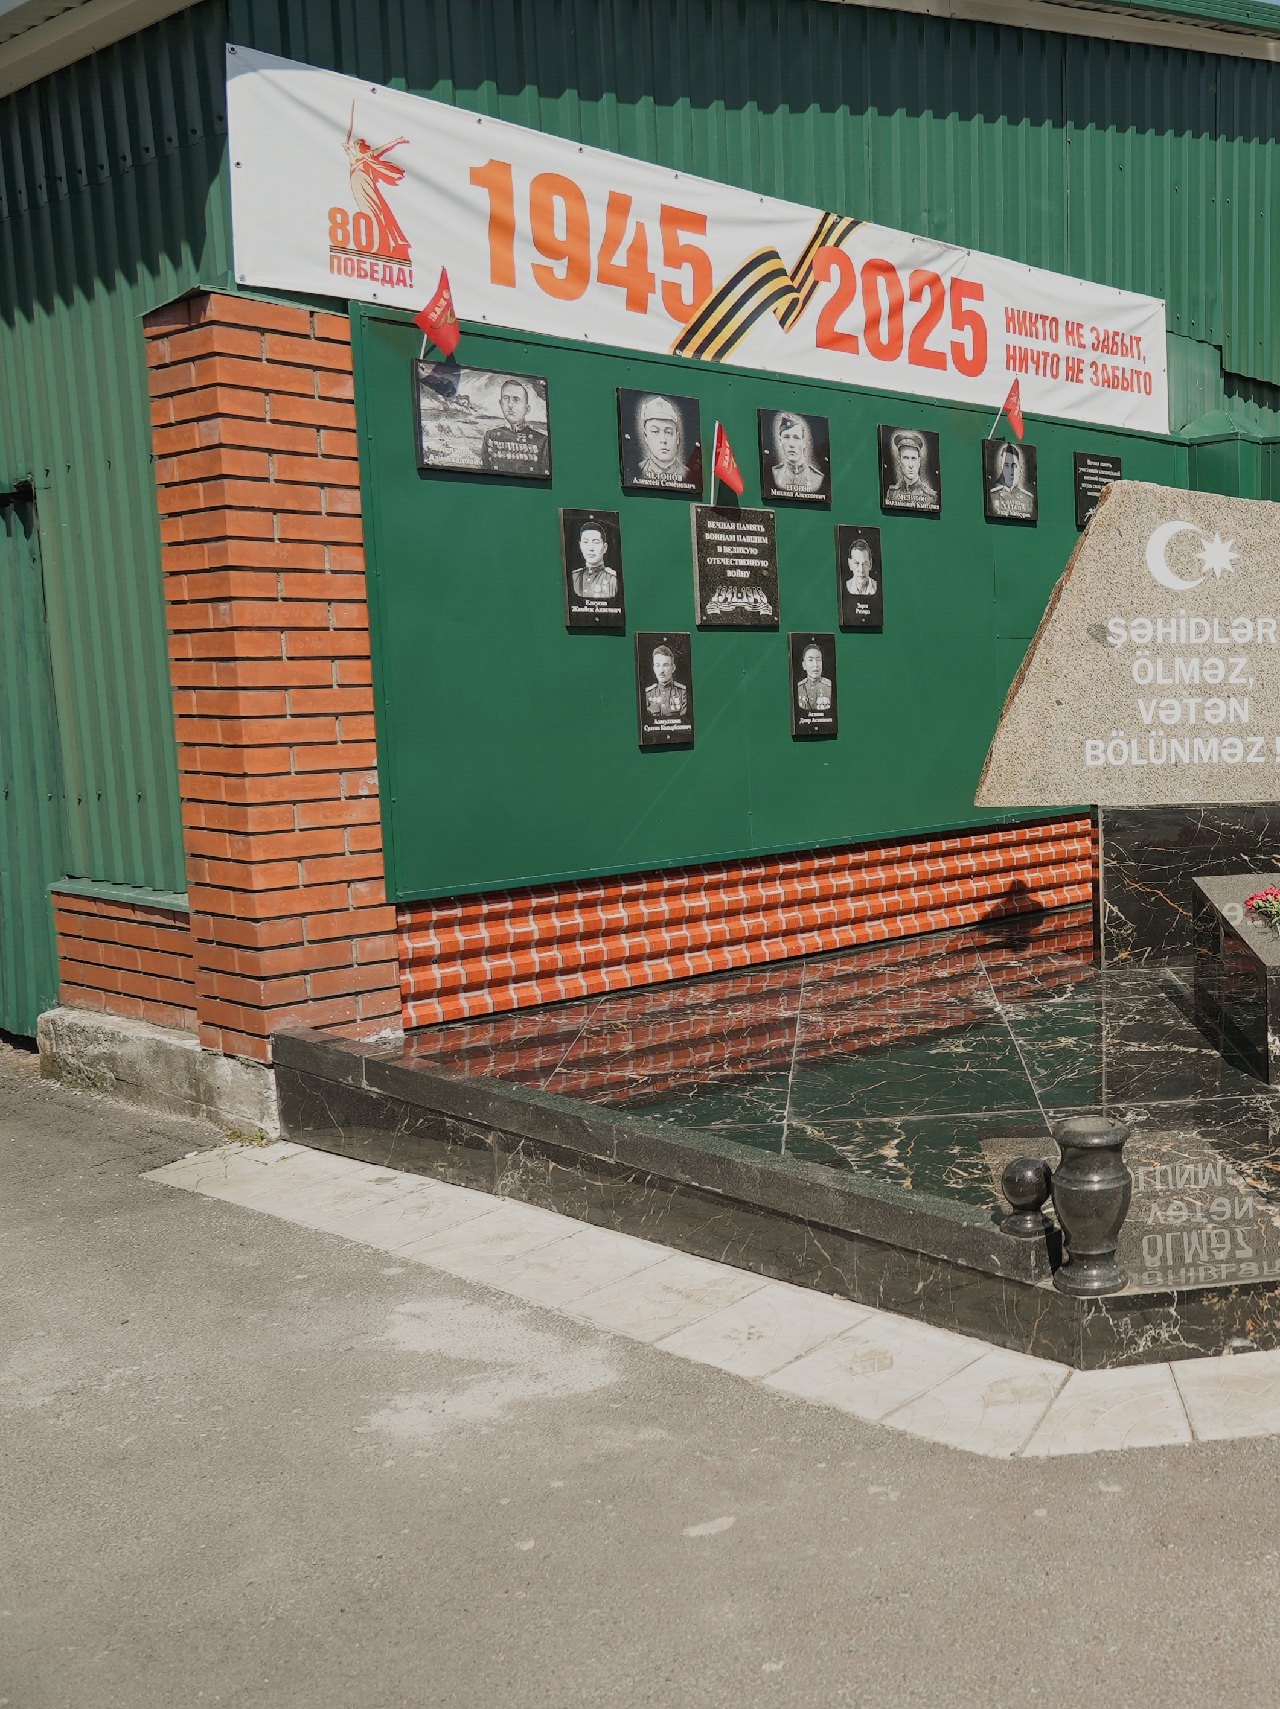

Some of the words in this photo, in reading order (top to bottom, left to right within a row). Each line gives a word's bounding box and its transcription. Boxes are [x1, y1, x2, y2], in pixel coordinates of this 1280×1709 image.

[328, 207, 374, 253] 80
[330, 254, 414, 288] ПОБЕДА!
[469, 159, 713, 324] 1945
[813, 246, 988, 378] 2025
[1004, 306, 1059, 343] НИКТО
[1065, 319, 1087, 349] НЕ
[1090, 326, 1146, 365] ЗАБЫТ,
[1005, 344, 1061, 380] НИЧТО
[1065, 356, 1085, 384] НЕ
[1089, 360, 1153, 396] ЗАБЫТО
[705, 532, 736, 542] ВОИНАМ
[707, 520, 736, 530] ВЕЧНАЯ
[736, 523, 766, 532] ПАМЯТЬ
[706, 557, 769, 568] ОТЕЧЕСТВЕННУЮ
[717, 545, 722, 553] В
[723, 546, 759, 555] ВЕЛИКУЮ
[726, 569, 751, 578] ВОЙНУ
[1106, 609, 1277, 648] ŞƏHİDLƏR
[1137, 698, 1250, 725] VƏTƏN
[1085, 730, 1266, 767] BÖLÜNMƏZ
